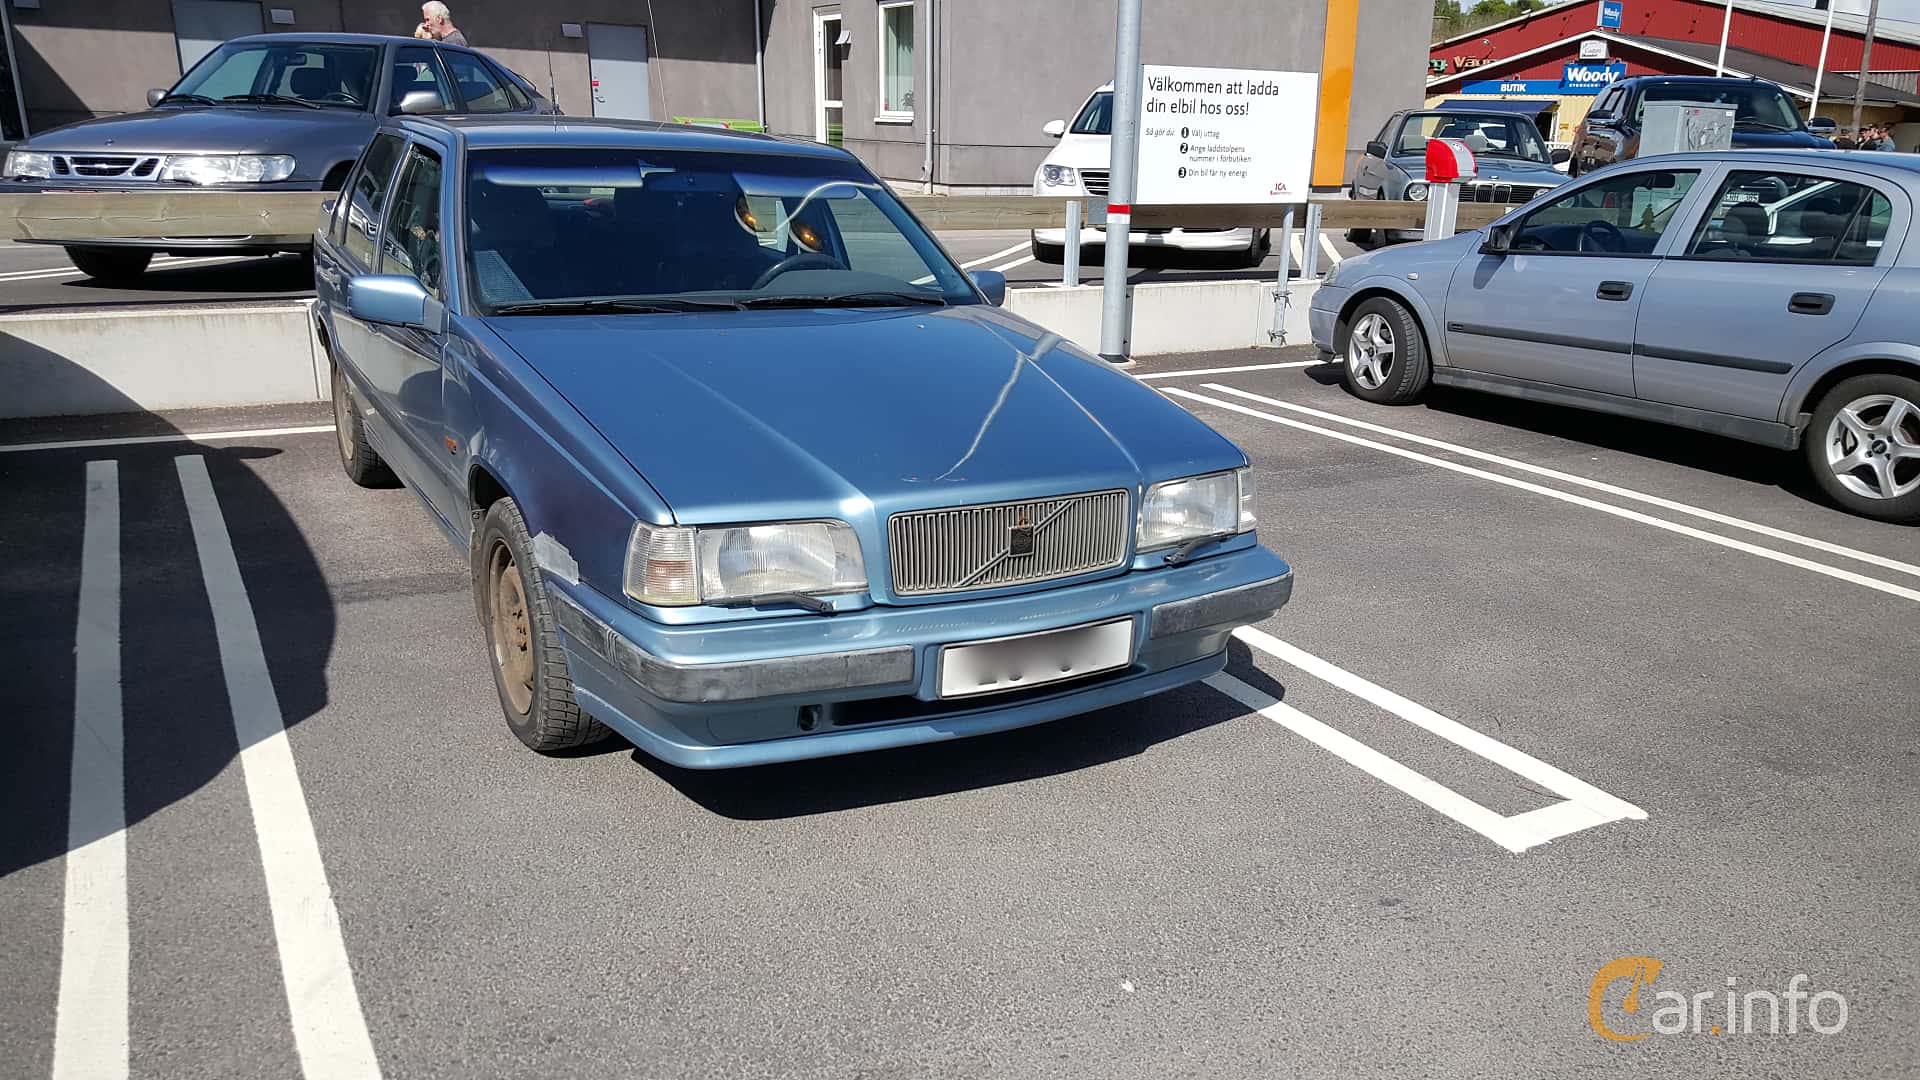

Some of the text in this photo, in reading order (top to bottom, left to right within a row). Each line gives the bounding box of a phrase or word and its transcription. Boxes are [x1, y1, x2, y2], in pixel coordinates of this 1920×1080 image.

[1567, 66, 1620, 85] Woody
[1148, 75, 1279, 96] Välkommen att ladda
[1500, 83, 1527, 92] BUTIK
[1146, 97, 1249, 115] din elbil hos oss!
[1203, 130, 1220, 139] uttag
[1189, 168, 1199, 176] Din
[1275, 182, 1287, 190] ICA
